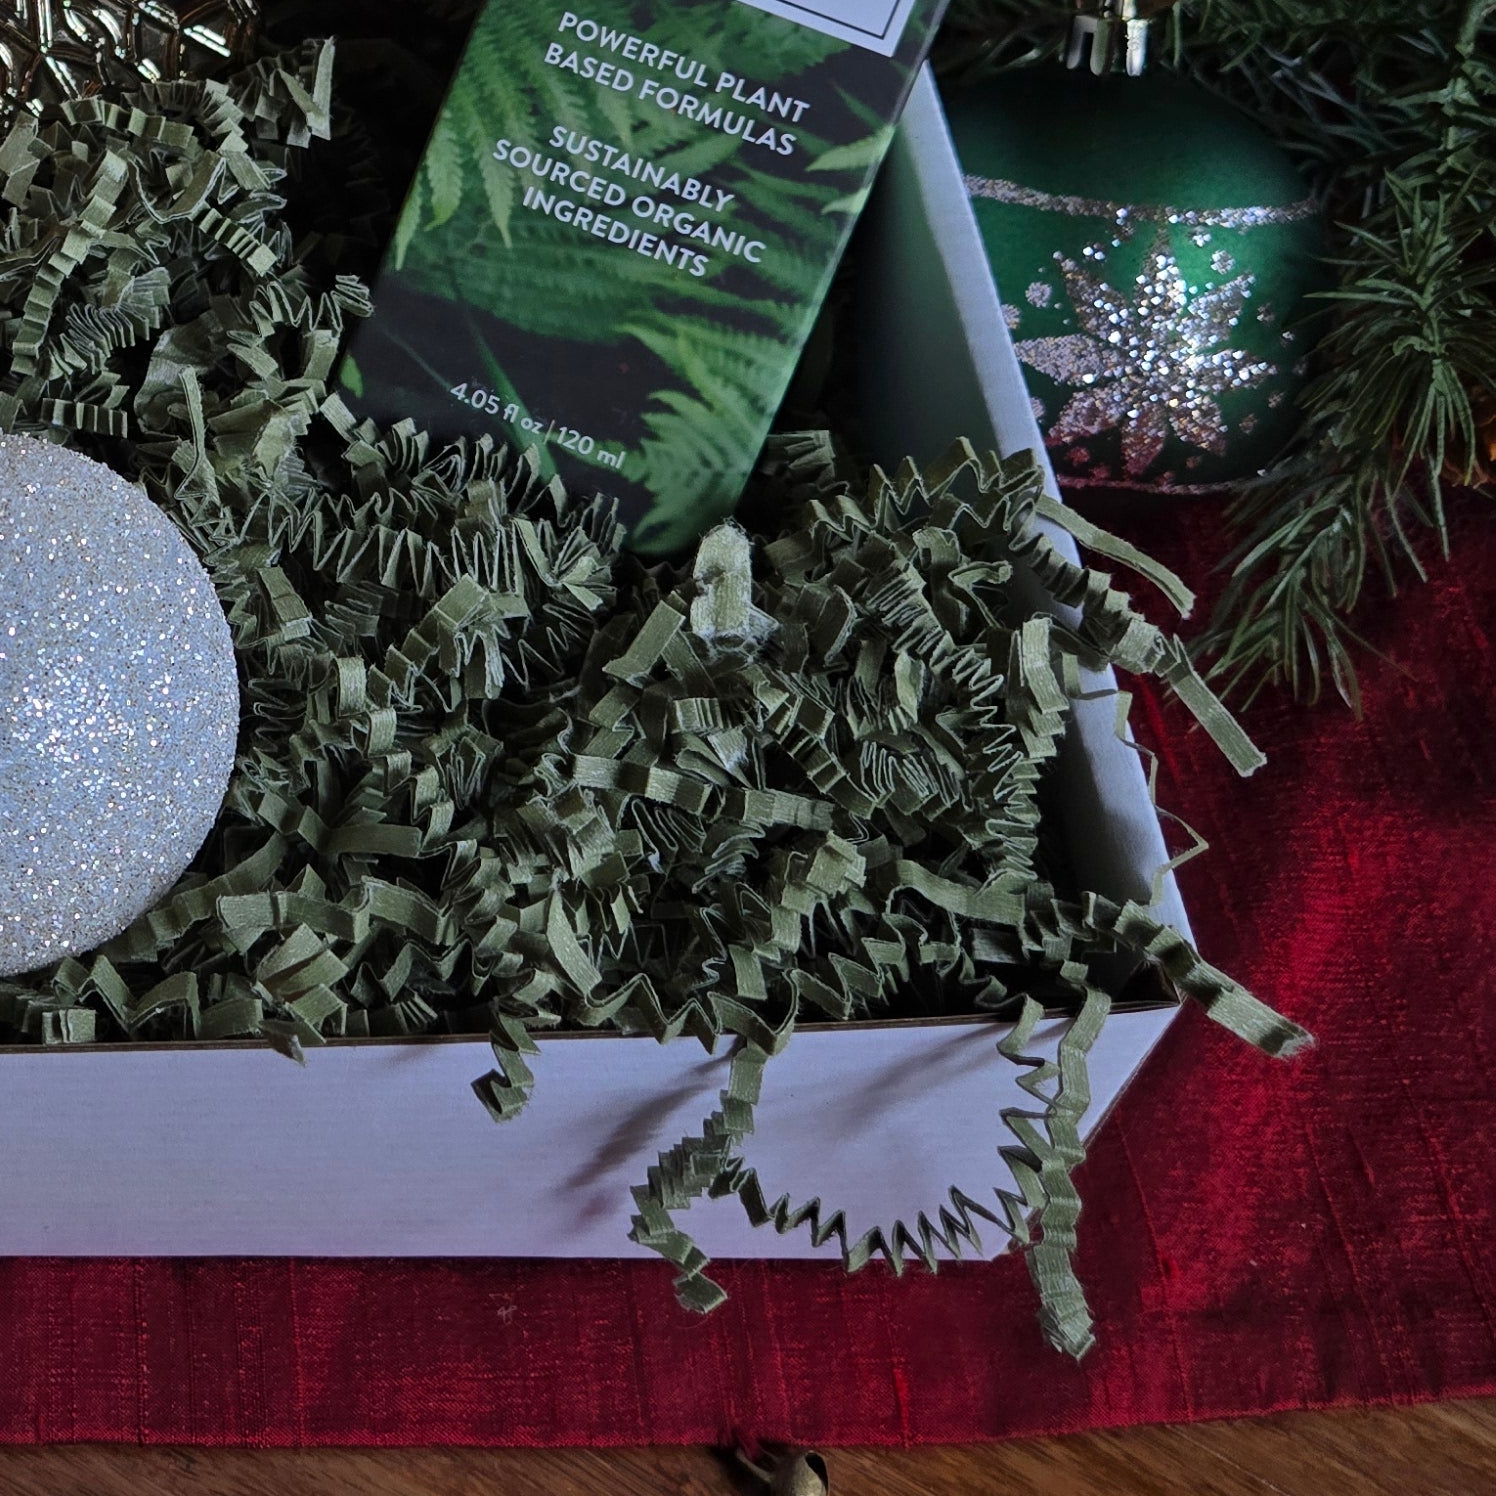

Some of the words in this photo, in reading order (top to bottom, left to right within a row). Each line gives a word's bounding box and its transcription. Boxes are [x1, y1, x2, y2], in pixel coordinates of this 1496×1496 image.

[543, 41, 635, 92] BASED
[638, 78, 797, 156] FORMULAS
[557, 11, 709, 88] POWERFUL
[714, 71, 810, 123] PLANT
[492, 138, 626, 207] SOURCED
[631, 195, 767, 264] ORGANIC
[549, 125, 735, 213] SUSTAINABLY
[522, 186, 710, 277] INGREDIENTS
[450, 382, 501, 415] 4.05
[503, 403, 520, 423] fl
[520, 418, 544, 435] oz
[556, 426, 595, 455] 120
[596, 449, 627, 469] ml
